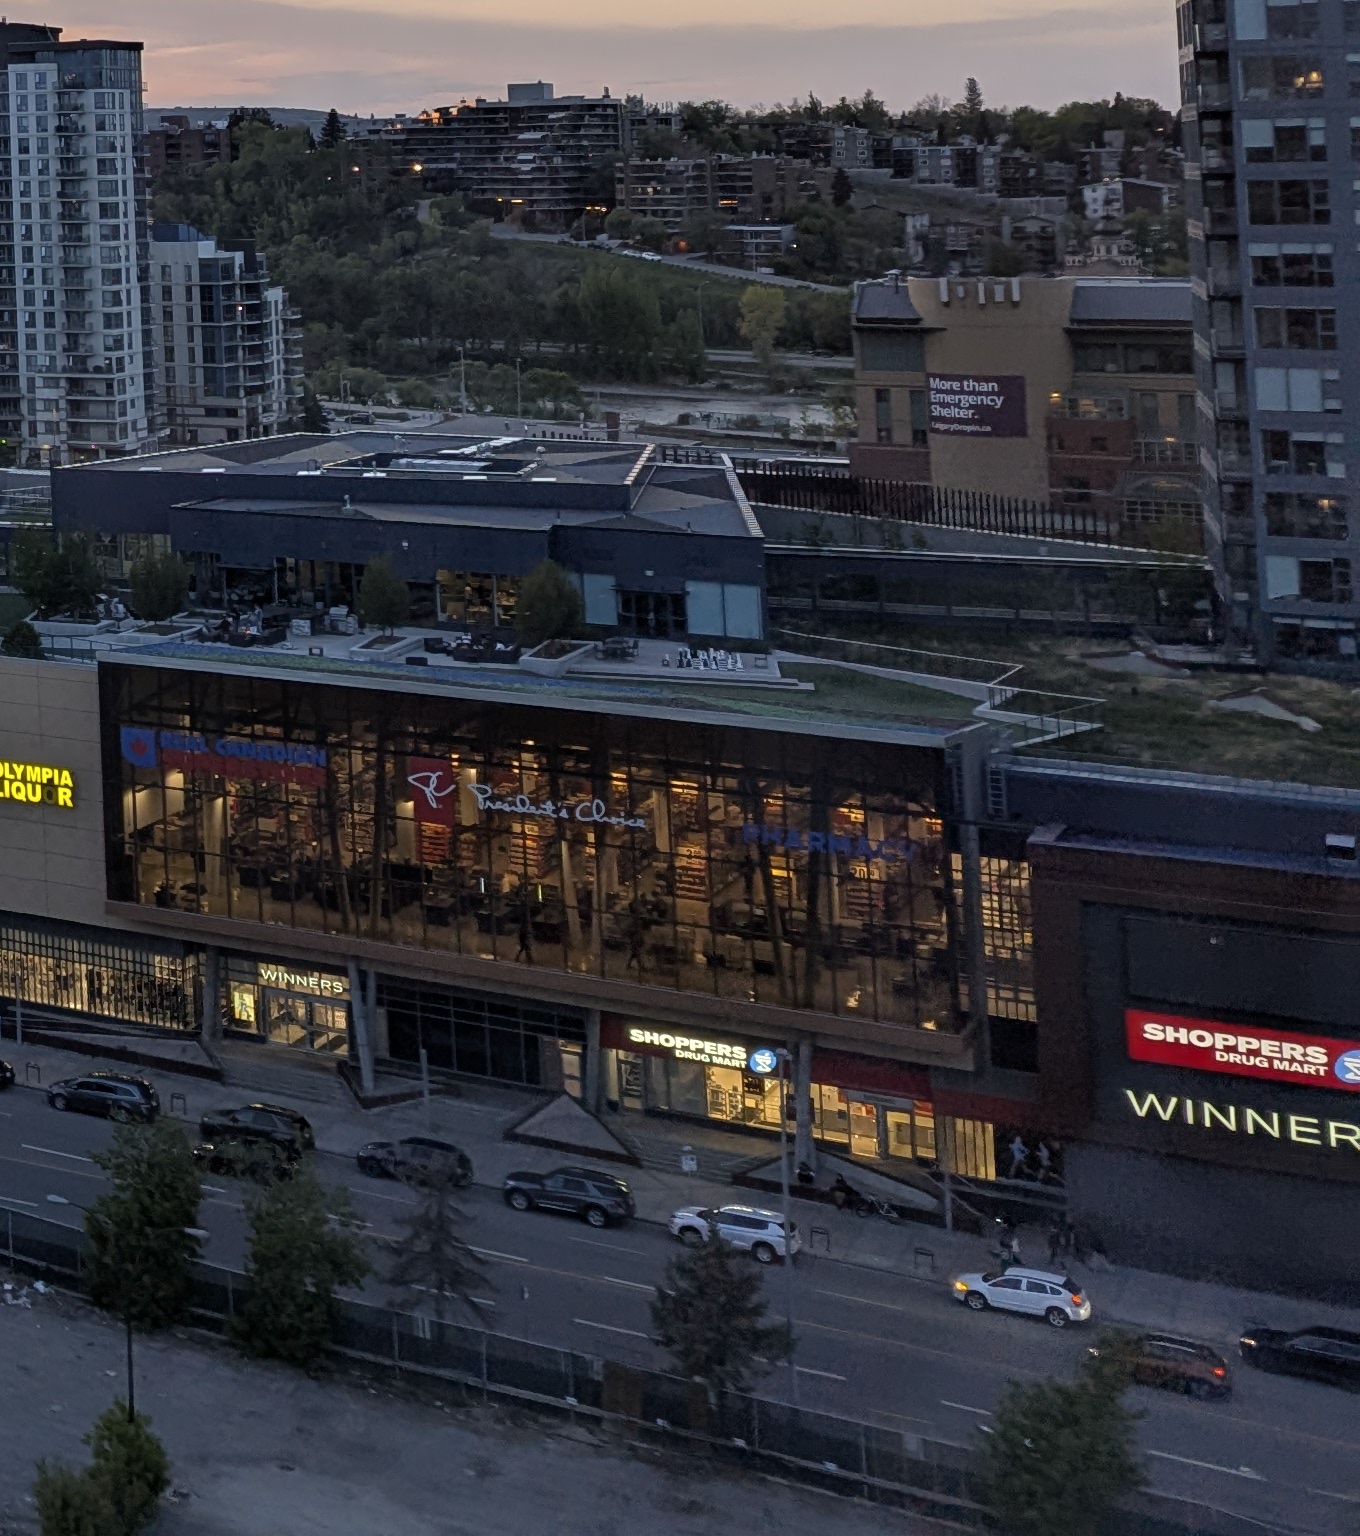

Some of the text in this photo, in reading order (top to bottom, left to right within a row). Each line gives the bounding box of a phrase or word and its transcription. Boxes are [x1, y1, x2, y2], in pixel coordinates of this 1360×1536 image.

[929, 377, 998, 392] More than
[930, 391, 1004, 409] Emergency
[931, 405, 979, 419] Shelter.
[216, 738, 328, 768] CANADIAN
[467, 783, 646, 828] President's Choice
[743, 823, 919, 861] PHARMACY
[260, 969, 344, 993] WINNERS
[629, 1028, 747, 1060] SHOPPERS
[1143, 1022, 1329, 1064] SHOPPERS
[675, 1049, 748, 1069] DRUG MART
[1215, 1050, 1329, 1077] DRUG MART
[1124, 1088, 1360, 1151] WINNER
